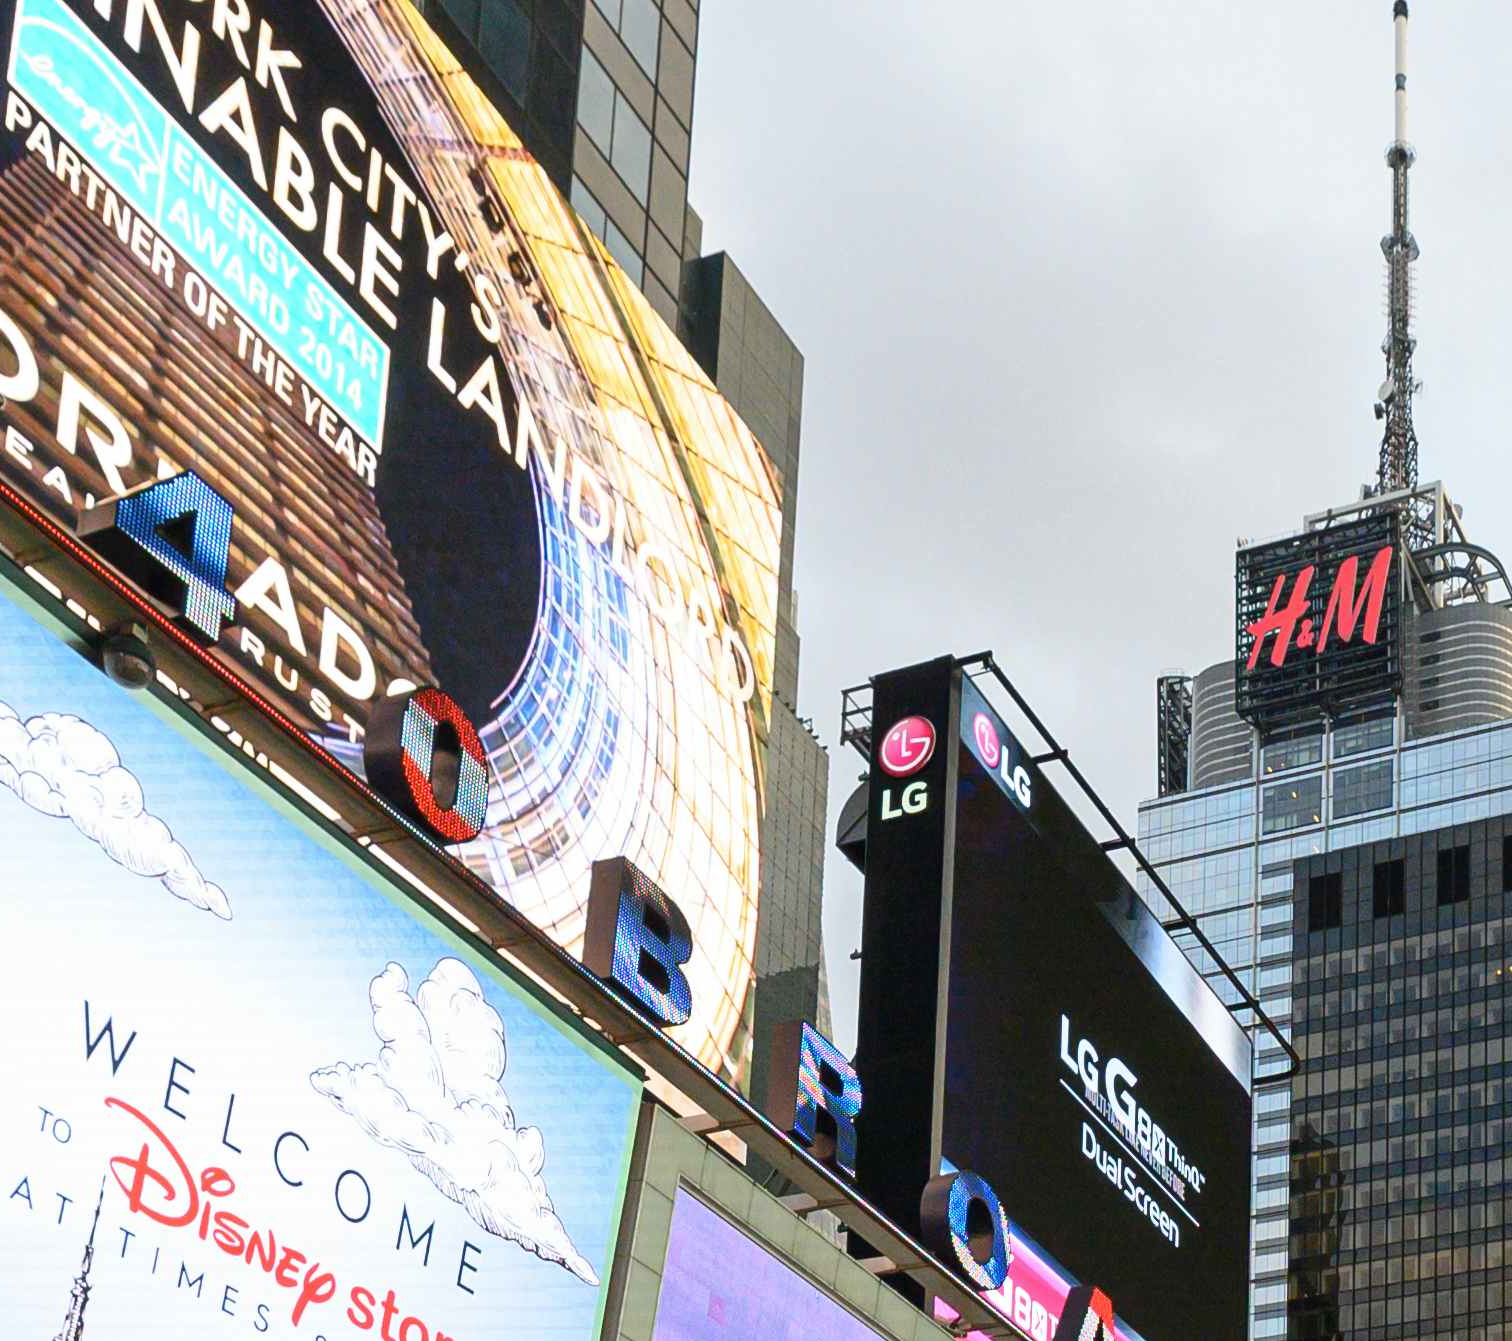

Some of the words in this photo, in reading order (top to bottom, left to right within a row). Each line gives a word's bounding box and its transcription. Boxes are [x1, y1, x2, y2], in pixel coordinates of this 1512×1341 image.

[92, 0, 404, 329] NABLE
[193, 0, 302, 122] RK
[322, 107, 503, 345] CITY'S
[6, 91, 175, 297] PARTNER
[183, 270, 231, 336] OF
[236, 309, 294, 400] THE
[294, 386, 382, 489] YEAR
[167, 197, 289, 337] AWARD
[299, 328, 363, 411] 2014
[173, 134, 299, 298] ENERGY
[308, 284, 381, 383] STAR
[238, 626, 365, 743] RUST
[1245, 546, 1393, 671] H&M
[881, 781, 929, 822] LG
[999, 744, 1033, 809] LG
[1060, 1014, 1099, 1093] LG
[38, 1107, 73, 1144] TO
[105, 1096, 337, 1327] Disney
[85, 1000, 482, 1295] WELCOME
[1082, 1122, 1123, 1190] Dual
[1124, 1166, 1180, 1248] Screen
[10, 1176, 74, 1225] AT
[119, 1227, 271, 1334] TIMES
